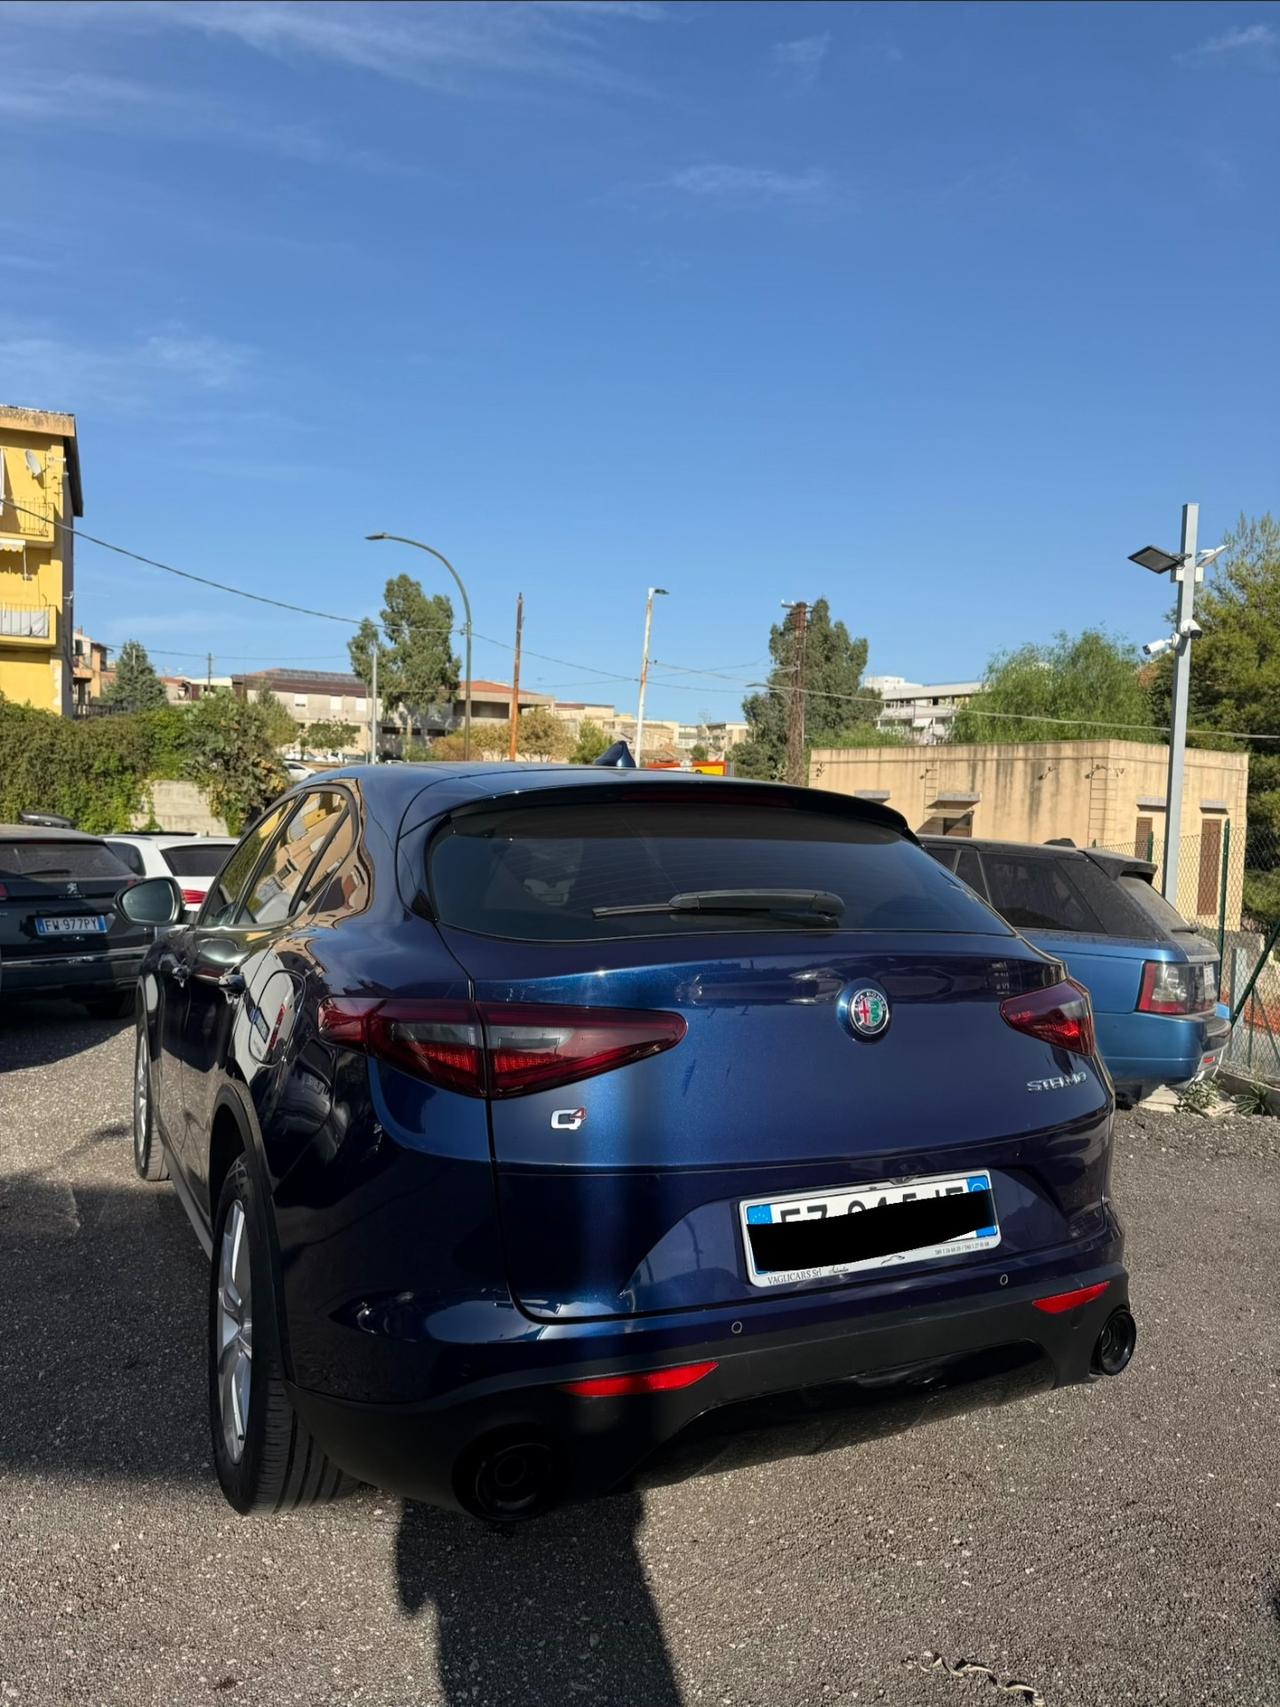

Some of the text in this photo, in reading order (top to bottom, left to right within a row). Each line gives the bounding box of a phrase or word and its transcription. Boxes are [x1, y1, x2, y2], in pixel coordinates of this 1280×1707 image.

[45, 917, 97, 931] FW 977PY
[767, 1270, 812, 1285] VAGLICARS
